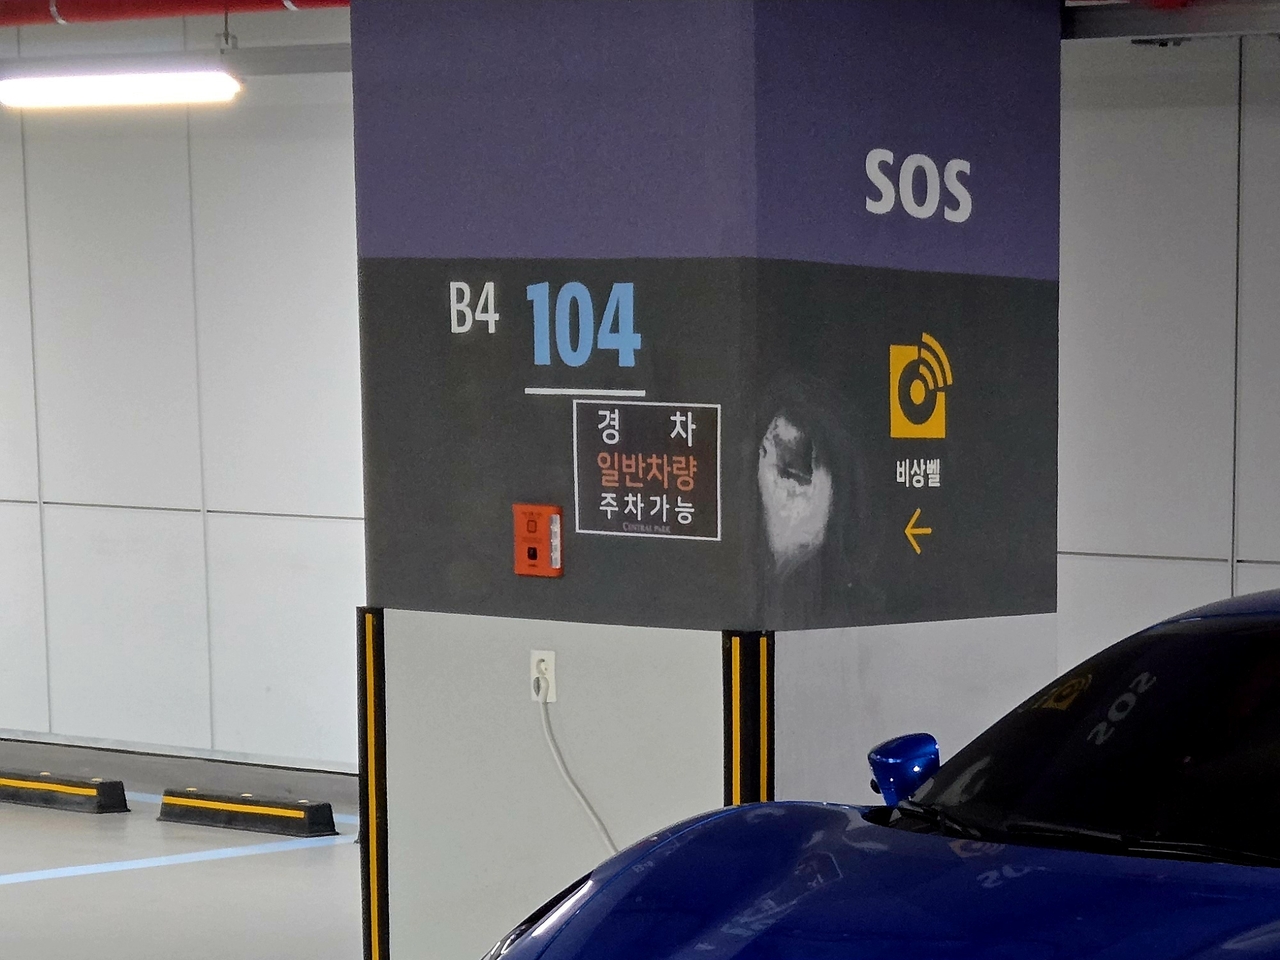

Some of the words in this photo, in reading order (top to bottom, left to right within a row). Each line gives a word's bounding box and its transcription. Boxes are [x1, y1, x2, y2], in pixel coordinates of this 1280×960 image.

[865, 148, 973, 223] SOS
[449, 281, 500, 334] B4
[526, 281, 642, 367] 104
[596, 452, 698, 491] 일반차량
[896, 458, 941, 488] 비상벨
